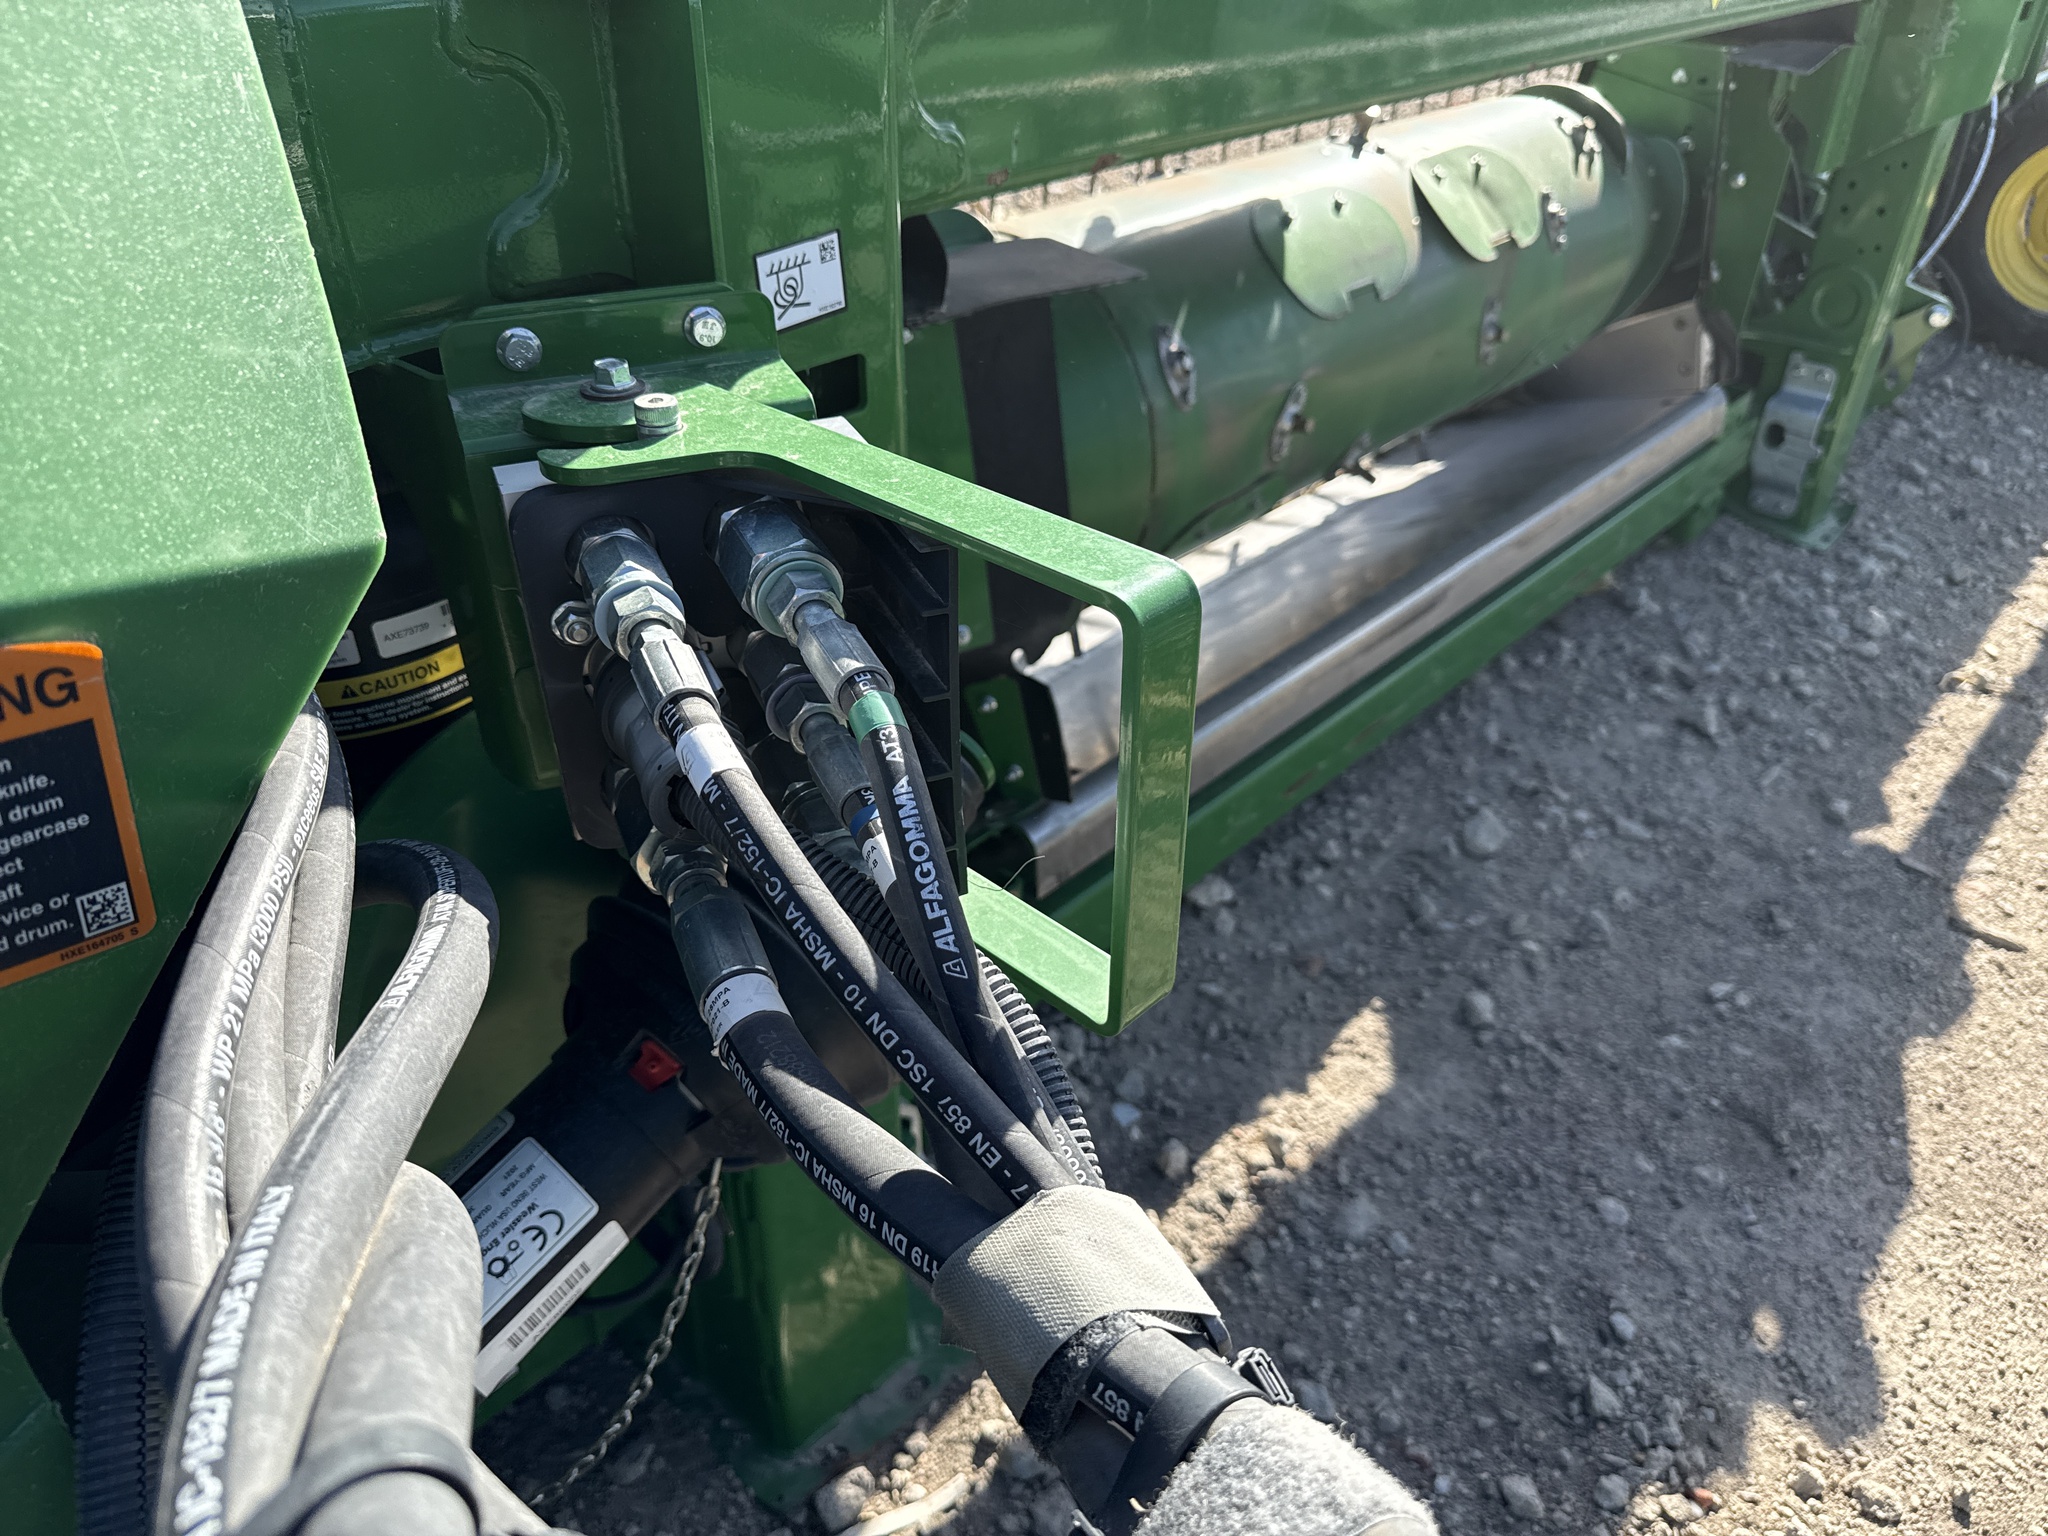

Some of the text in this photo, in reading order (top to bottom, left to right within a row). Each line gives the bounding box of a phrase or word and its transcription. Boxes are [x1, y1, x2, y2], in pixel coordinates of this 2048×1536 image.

[360, 661, 441, 695] CAUTION
[878, 724, 905, 763] AT3
[8, 795, 64, 822] drum
[0, 813, 90, 855] gearcase
[892, 775, 961, 953] ALFAGOMMA
[49, 893, 70, 909] or
[14, 918, 74, 946] drum.
[130, 926, 140, 936] S
[784, 903, 836, 972] MSHA
[231, 949, 260, 1004] MPa
[844, 982, 867, 1011] 10
[222, 1001, 245, 1037] 21
[866, 1013, 900, 1050] DN
[211, 1033, 235, 1081] WP
[897, 1049, 935, 1094] 1SC
[728, 1050, 758, 1104] MADE
[758, 1100, 810, 1168] IC-152/7
[938, 1096, 973, 1136] 857
[968, 1132, 1003, 1169] EN
[499, 1178, 521, 1198] YEAR
[528, 1172, 548, 1192] WEST
[812, 1158, 857, 1213] MSHA
[497, 1206, 513, 1221] USA
[500, 1201, 540, 1239] Weasler
[858, 1203, 876, 1229] 16
[881, 1220, 908, 1257] DN
[198, 1281, 258, 1379] MADE
[239, 1184, 294, 1251] ITALY
[1092, 1382, 1129, 1422] 857
